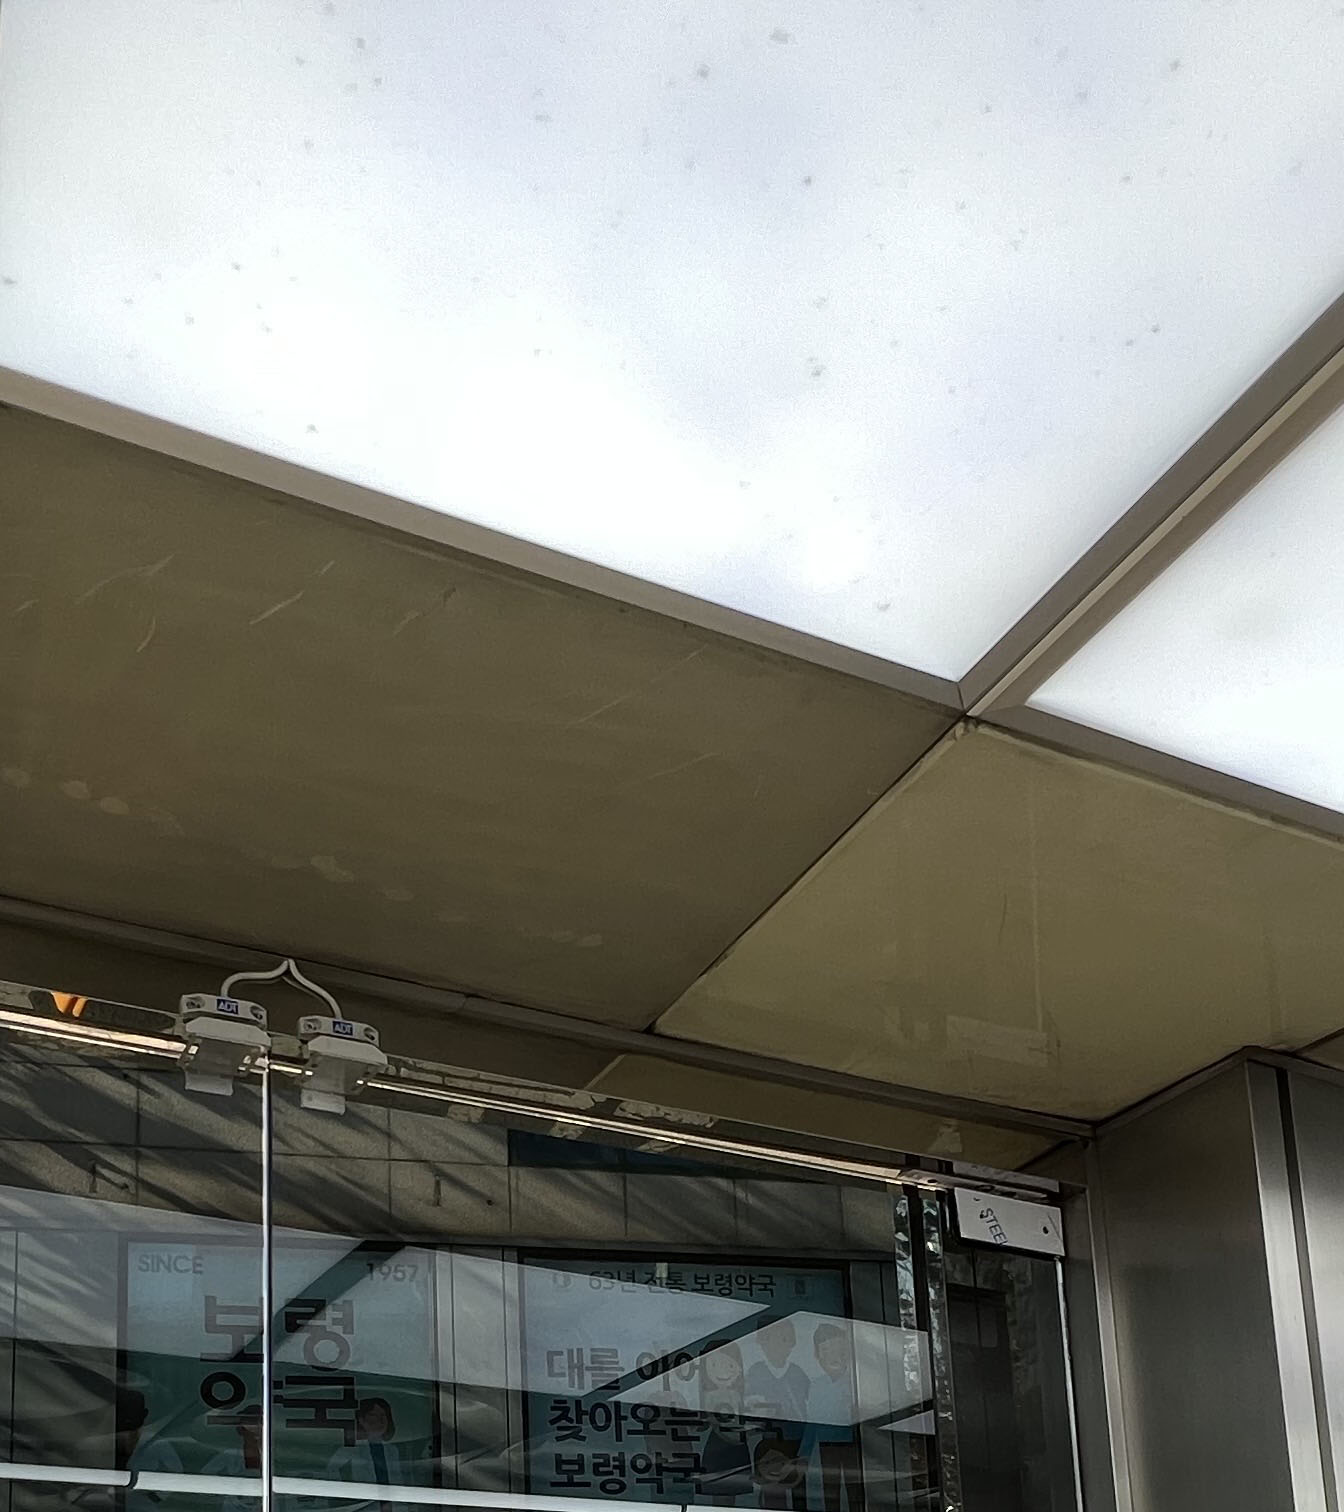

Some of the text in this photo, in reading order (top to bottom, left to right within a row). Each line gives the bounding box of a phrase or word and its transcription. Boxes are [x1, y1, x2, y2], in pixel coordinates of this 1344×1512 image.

[218, 1001, 239, 1013] ADT
[334, 1022, 353, 1035] ADT
[138, 1255, 418, 1283] SINCE 1957
[693, 1273, 777, 1298] 보령약국
[200, 1296, 355, 1372] 보령
[546, 1348, 624, 1391] 대를
[200, 1371, 357, 1448] 약국
[548, 1400, 704, 1442] 찾아오는
[550, 1451, 704, 1496] 보령약국
